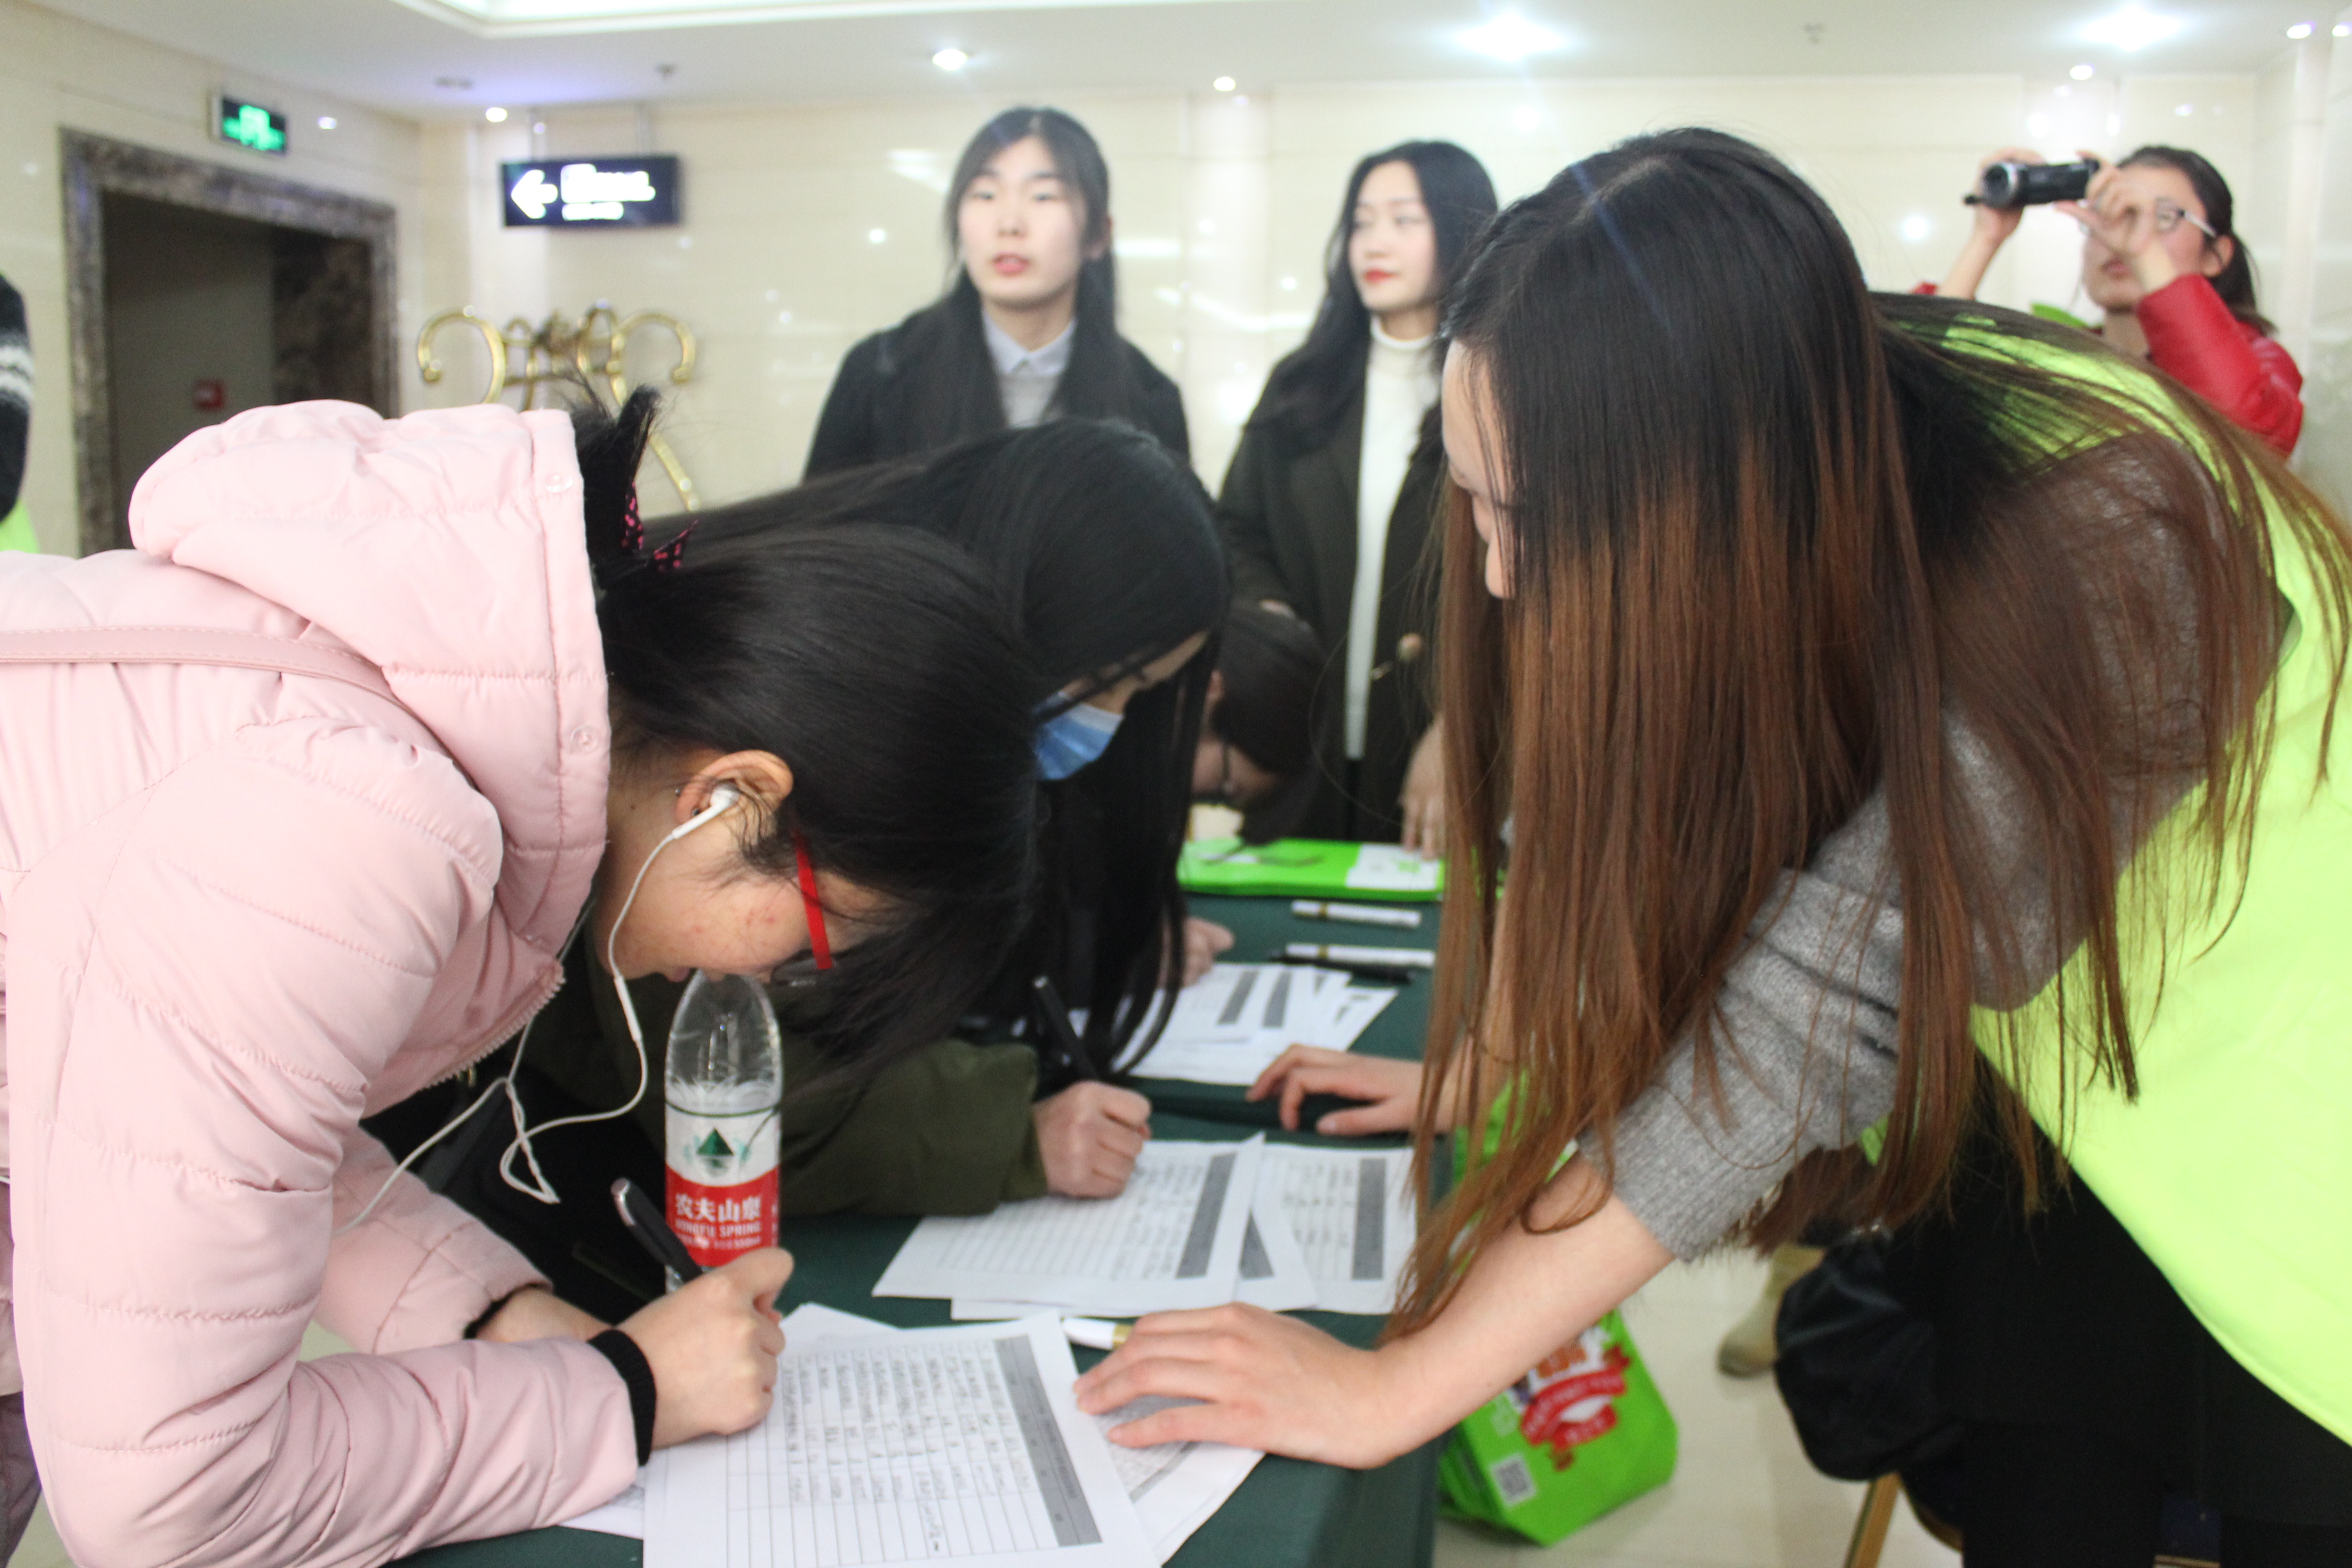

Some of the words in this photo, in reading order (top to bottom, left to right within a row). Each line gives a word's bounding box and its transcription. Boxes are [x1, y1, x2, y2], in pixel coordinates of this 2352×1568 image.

[676, 1194, 761, 1222] 农夫山泉
[719, 1220, 761, 1237] SPRING
